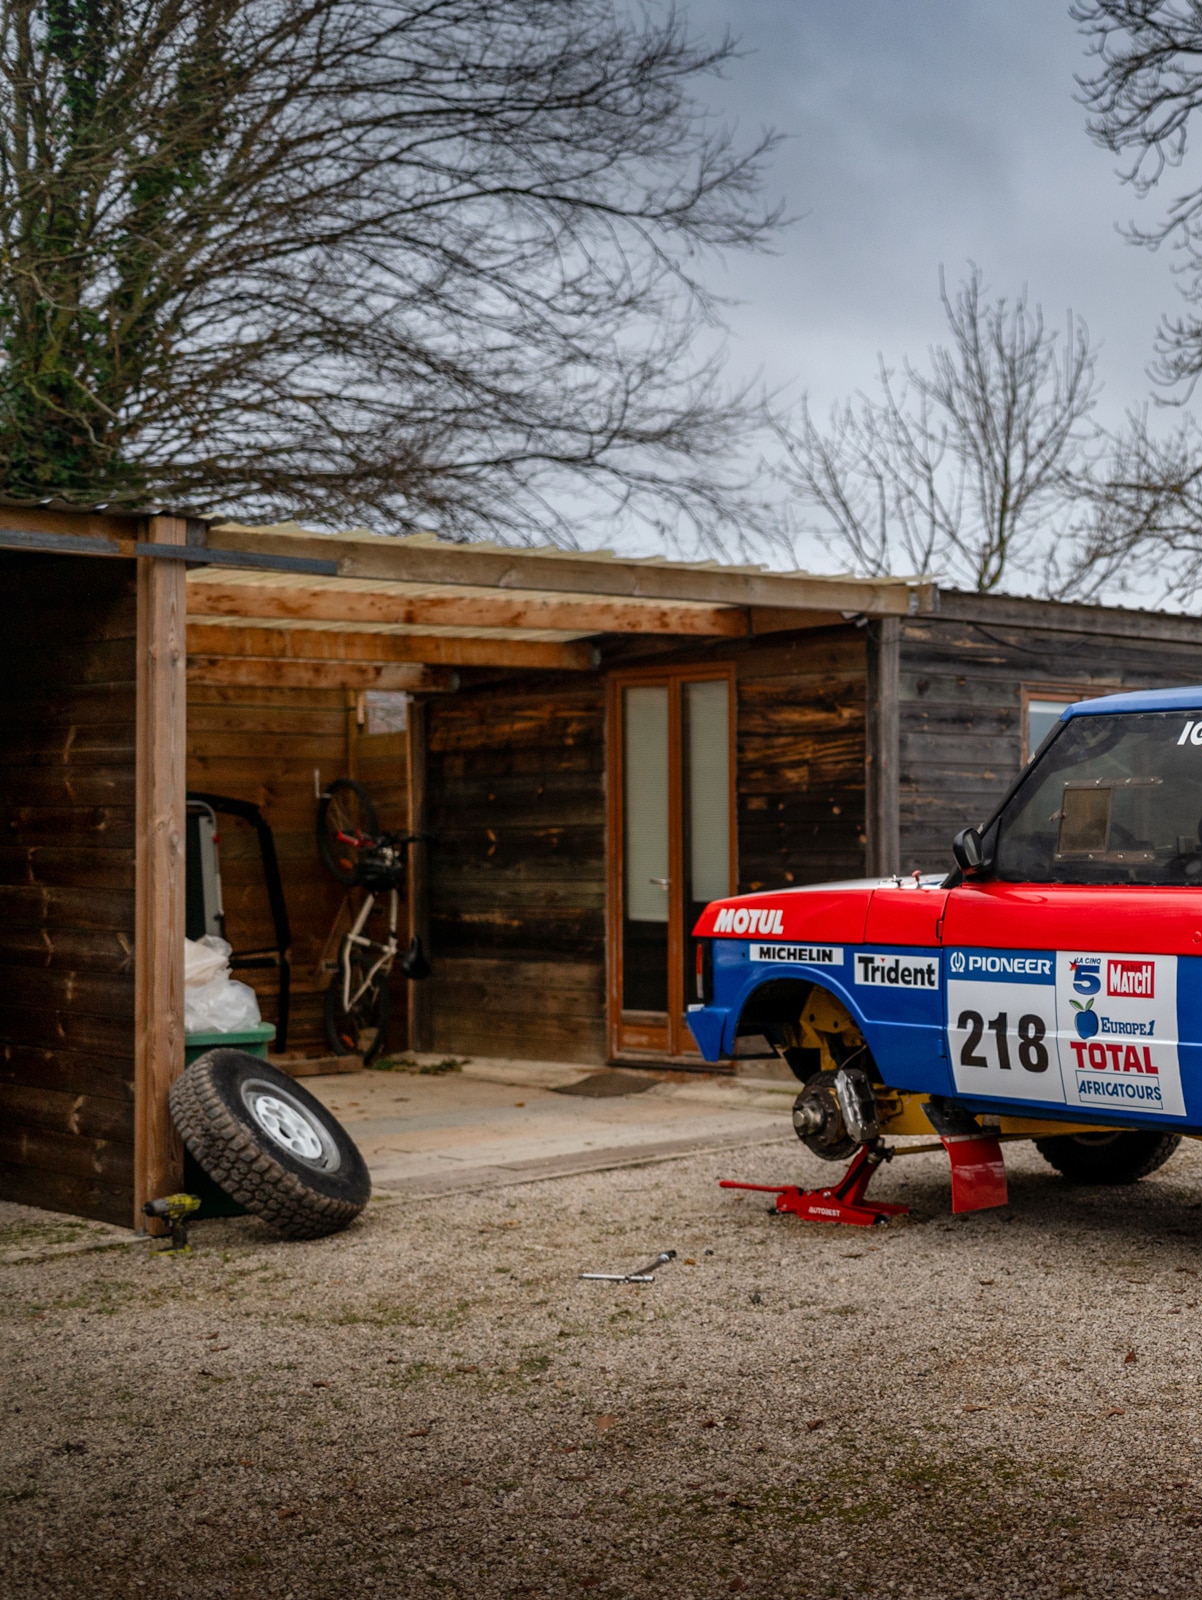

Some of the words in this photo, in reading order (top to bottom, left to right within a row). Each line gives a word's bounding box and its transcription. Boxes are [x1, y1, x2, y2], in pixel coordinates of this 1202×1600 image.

[713, 908, 784, 934] MOTUL
[759, 947, 833, 962] MICHELIN
[969, 956, 1053, 974] PIONEER
[858, 956, 936, 987] Trident
[1073, 965, 1101, 995] 5
[1109, 963, 1152, 994] MATCH
[957, 1010, 1049, 1073] 218
[1070, 1041, 1159, 1074] TOTAL
[1078, 1079, 1162, 1101] AFRICATOURS
